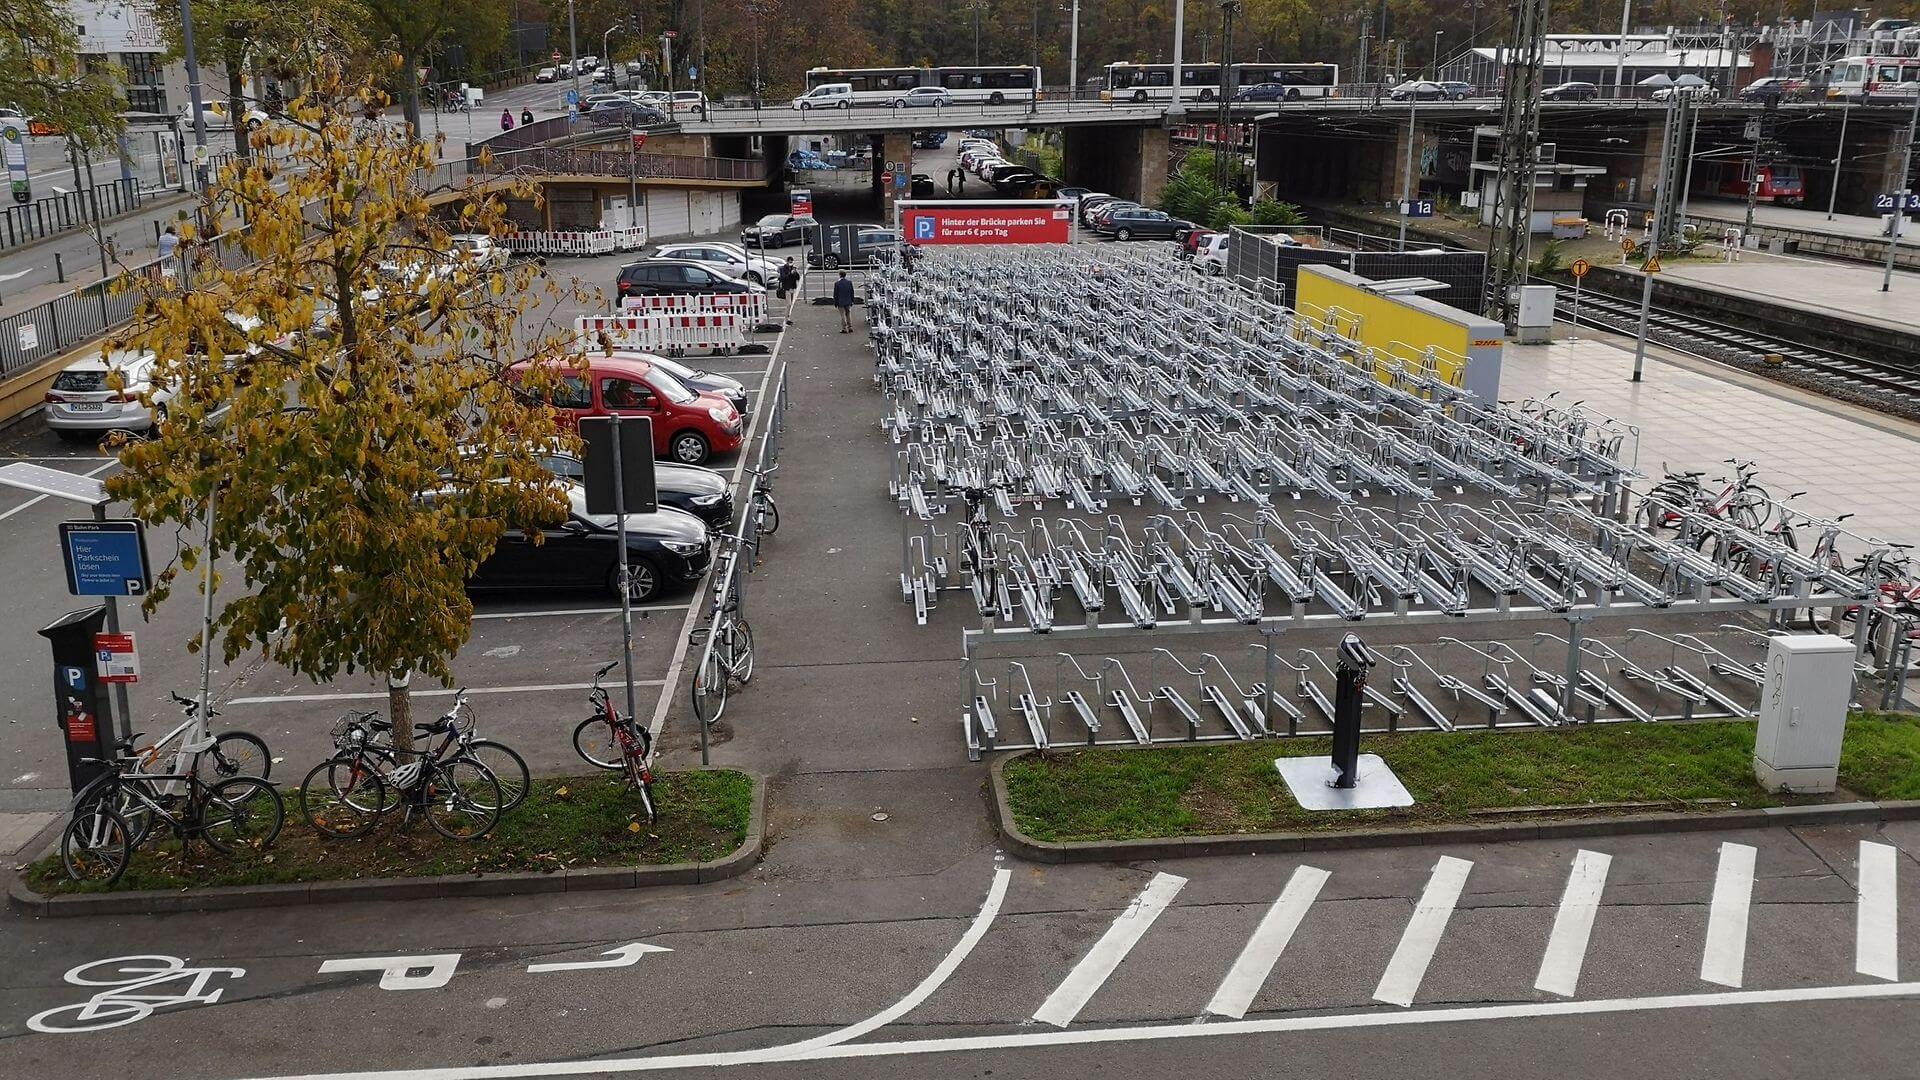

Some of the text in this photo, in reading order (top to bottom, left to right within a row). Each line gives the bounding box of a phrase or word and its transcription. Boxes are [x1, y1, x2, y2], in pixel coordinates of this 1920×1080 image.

[1417, 201, 1431, 214] 1a
[1877, 194, 1893, 208] 2a
[1910, 194, 1920, 208] 3
[941, 216, 1046, 227] Hinter der Brücke parken Sie
[941, 228, 953, 236] für
[967, 228, 973, 236] 6
[973, 228, 979, 236] €
[979, 229, 993, 237] pro
[994, 228, 1008, 237] Tag
[76, 545, 92, 553] Hier
[77, 554, 120, 562] Parkschein
[127, 579, 141, 596] P
[68, 668, 82, 686] P
[318, 954, 462, 990] P
